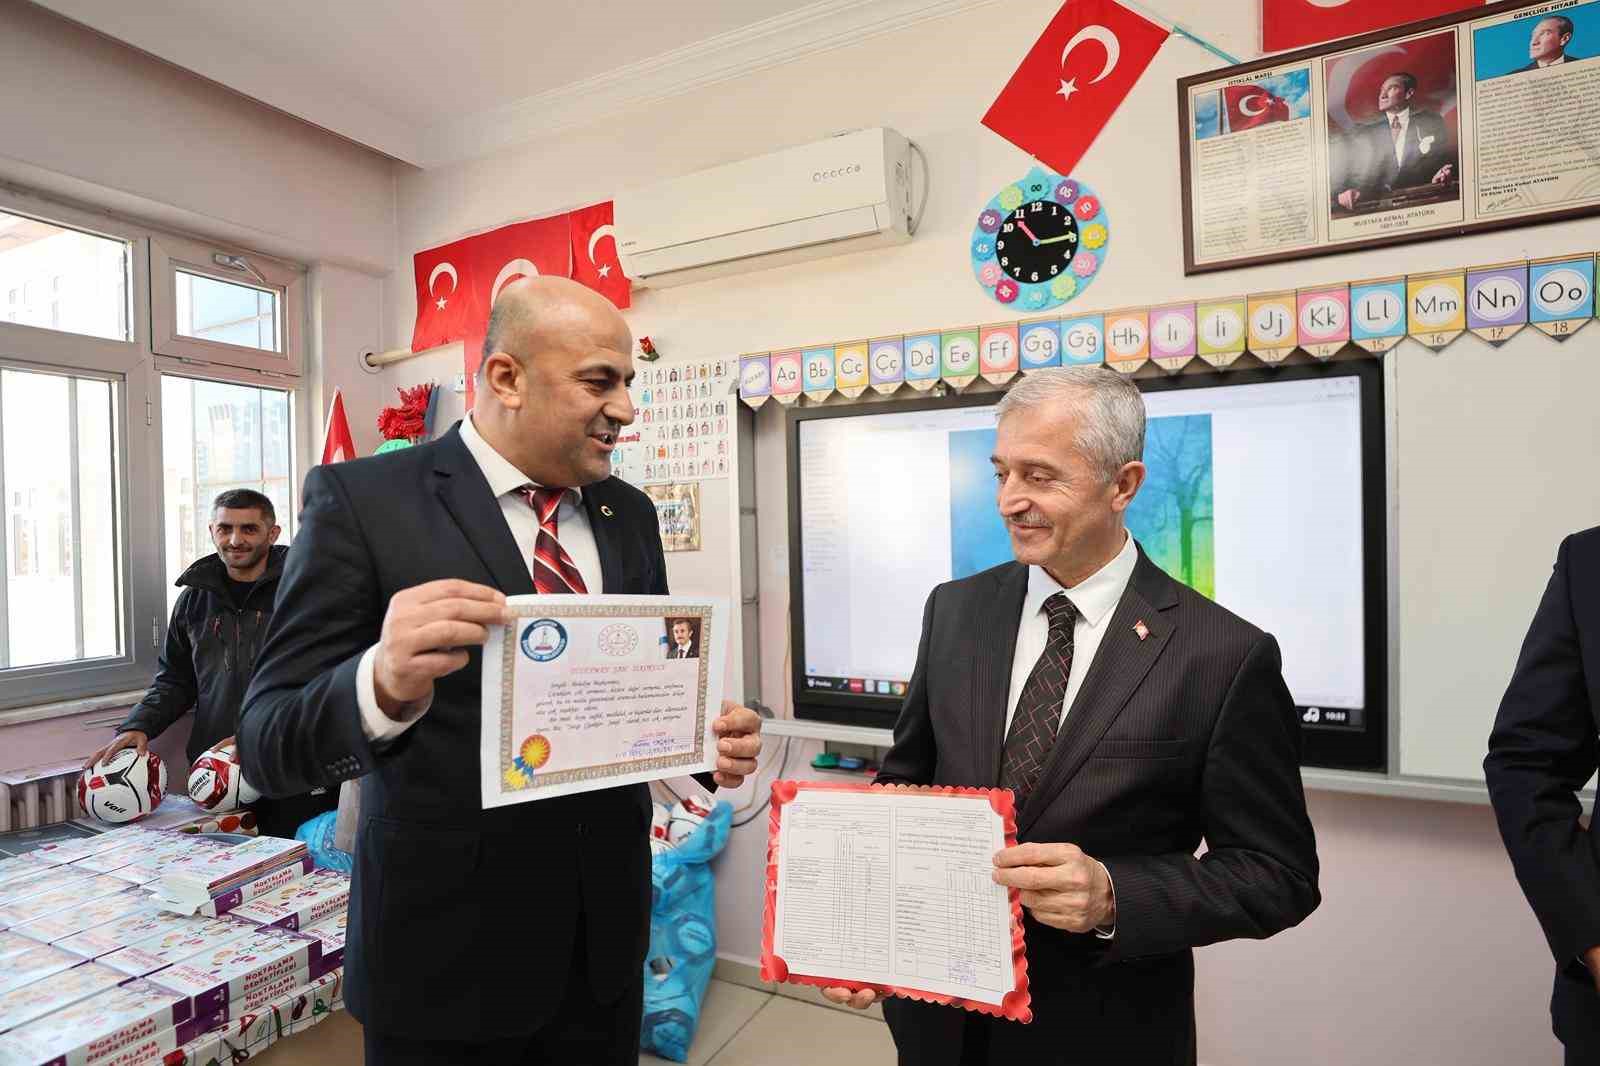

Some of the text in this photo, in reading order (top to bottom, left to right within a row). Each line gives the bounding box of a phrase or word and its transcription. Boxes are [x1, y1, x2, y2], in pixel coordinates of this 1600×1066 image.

[1015, 209, 1025, 219] 11
[1031, 202, 1042, 212] 12
[1052, 206, 1057, 216] 1
[1003, 223, 1014, 233] 10
[1064, 216, 1071, 226] 2
[997, 240, 1004, 250] 9
[1001, 257, 1008, 266] 8
[1064, 250, 1071, 259] 4
[1014, 267, 1021, 277] 7
[1031, 272, 1039, 281] 6
[1051, 265, 1058, 275] 5
[1477, 287, 1516, 310] Nn
[1540, 280, 1582, 303] Oo
[1367, 299, 1389, 321] Ll
[1415, 295, 1457, 315] Mm
[1260, 311, 1283, 337] Jj
[1310, 306, 1337, 327] Kk
[1490, 327, 1504, 339] 17
[1552, 322, 1568, 334] 18
[1112, 327, 1140, 346] Hh
[1430, 334, 1445, 345] 16
[989, 340, 1009, 360] Ff
[1024, 334, 1052, 358] Gg
[1317, 345, 1329, 356] 14
[1371, 340, 1385, 350] 15
[911, 348, 934, 367] Dd
[950, 345, 970, 363] Ee
[1216, 354, 1227, 364] 12
[1267, 349, 1279, 360] 13
[809, 362, 828, 378] Bb
[841, 358, 862, 374] Cc
[1121, 361, 1133, 371] 10
[1169, 358, 1178, 367] 11
[777, 367, 796, 382] Aa
[254, 868, 292, 889] NOKTALAMA
[245, 956, 295, 981] NOKTALAMA
[244, 962, 297, 991] DEDEKTİFLERİ
[246, 975, 296, 1001] NOKTALAMA
[244, 982, 297, 1010] DEDEKTİFLERİ
[88, 1018, 155, 1050] NOKTALAMA
[86, 1025, 157, 1063] DEDEKTİFLERİ
